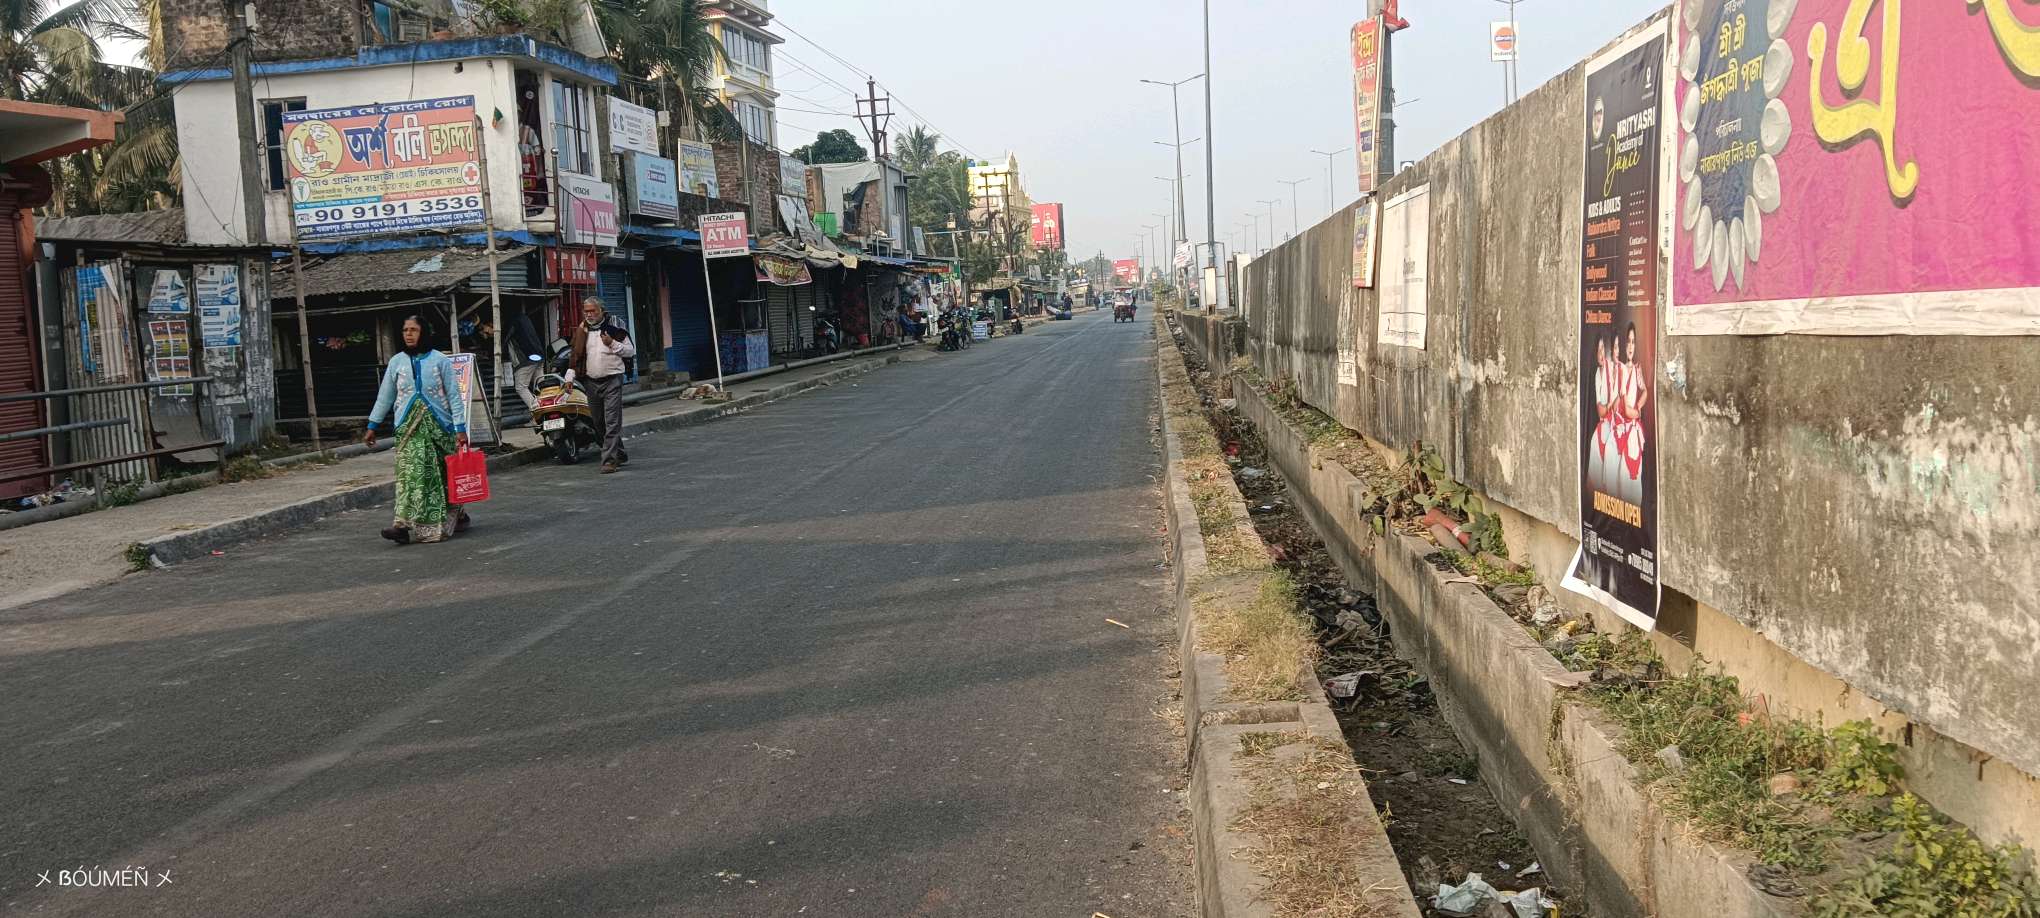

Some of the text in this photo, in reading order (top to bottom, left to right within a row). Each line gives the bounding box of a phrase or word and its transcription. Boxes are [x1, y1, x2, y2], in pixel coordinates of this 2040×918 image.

[1741, 54, 1764, 93] পূজা
[434, 97, 467, 108] রোগ
[1616, 105, 1656, 140] NRITYASRI
[315, 208, 344, 222] 90
[352, 202, 408, 218] 9191
[420, 196, 479, 212] 3536
[703, 214, 735, 222] HITACHI
[1587, 201, 1599, 218] KIDS
[1603, 195, 1621, 215] ADULTS
[594, 210, 614, 230] ATM
[706, 226, 742, 242] ATM
[1594, 490, 1642, 529] ADMISSION OPEN
